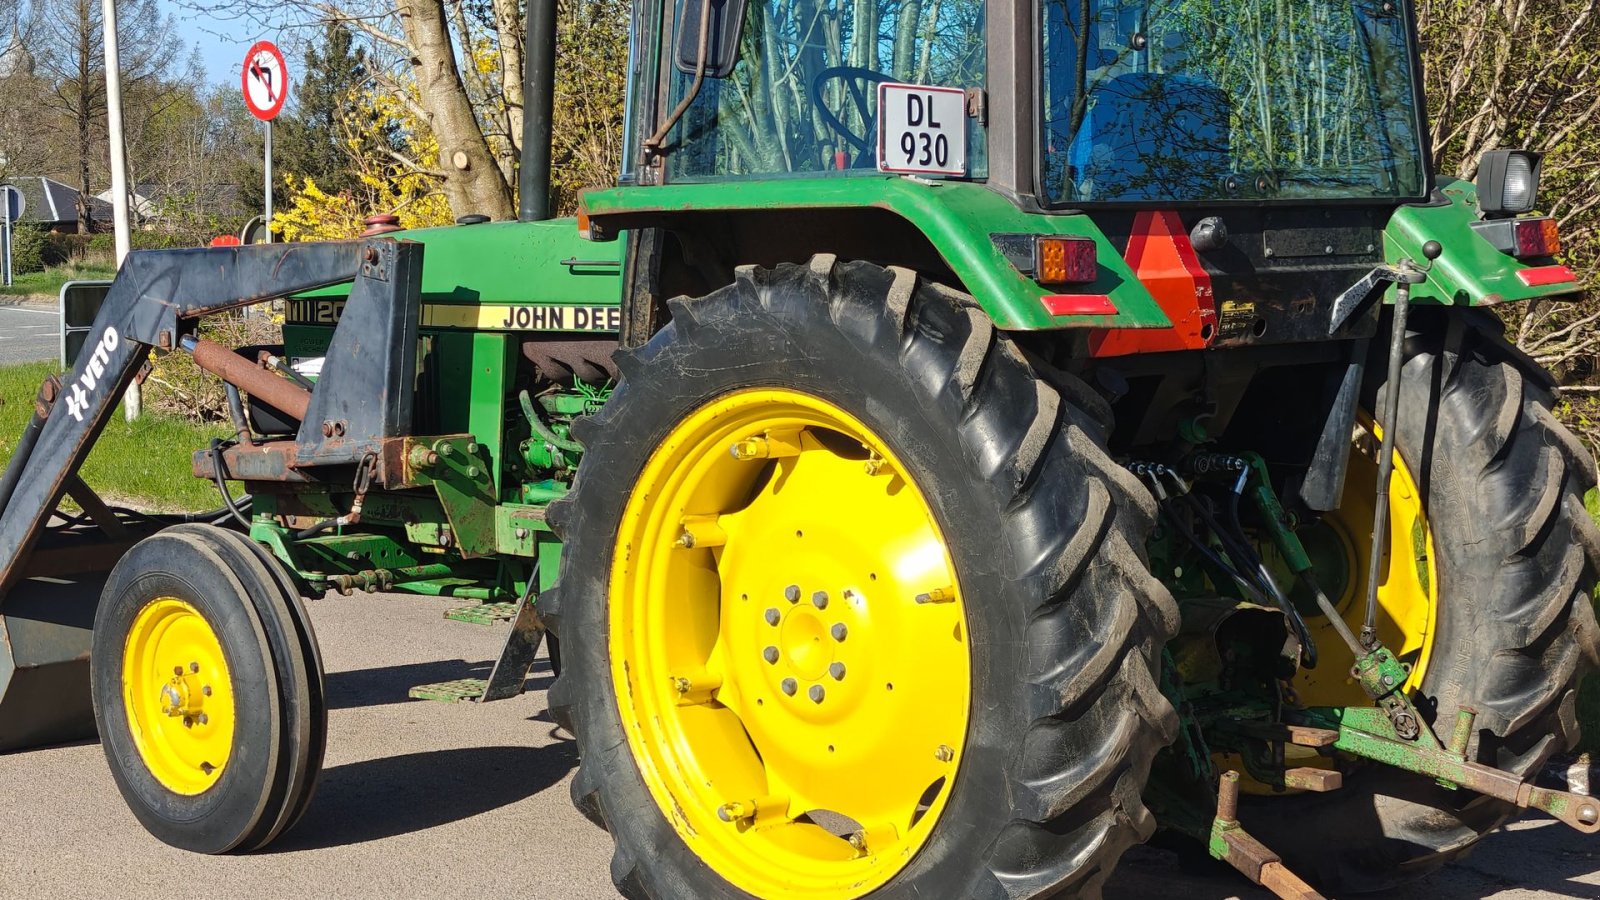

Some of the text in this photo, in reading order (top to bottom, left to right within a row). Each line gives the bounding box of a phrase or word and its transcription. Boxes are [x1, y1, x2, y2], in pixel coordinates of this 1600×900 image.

[907, 93, 941, 129] DL
[900, 131, 948, 168] 930
[503, 307, 620, 331] JOHN DEE
[80, 326, 119, 391] VETO
